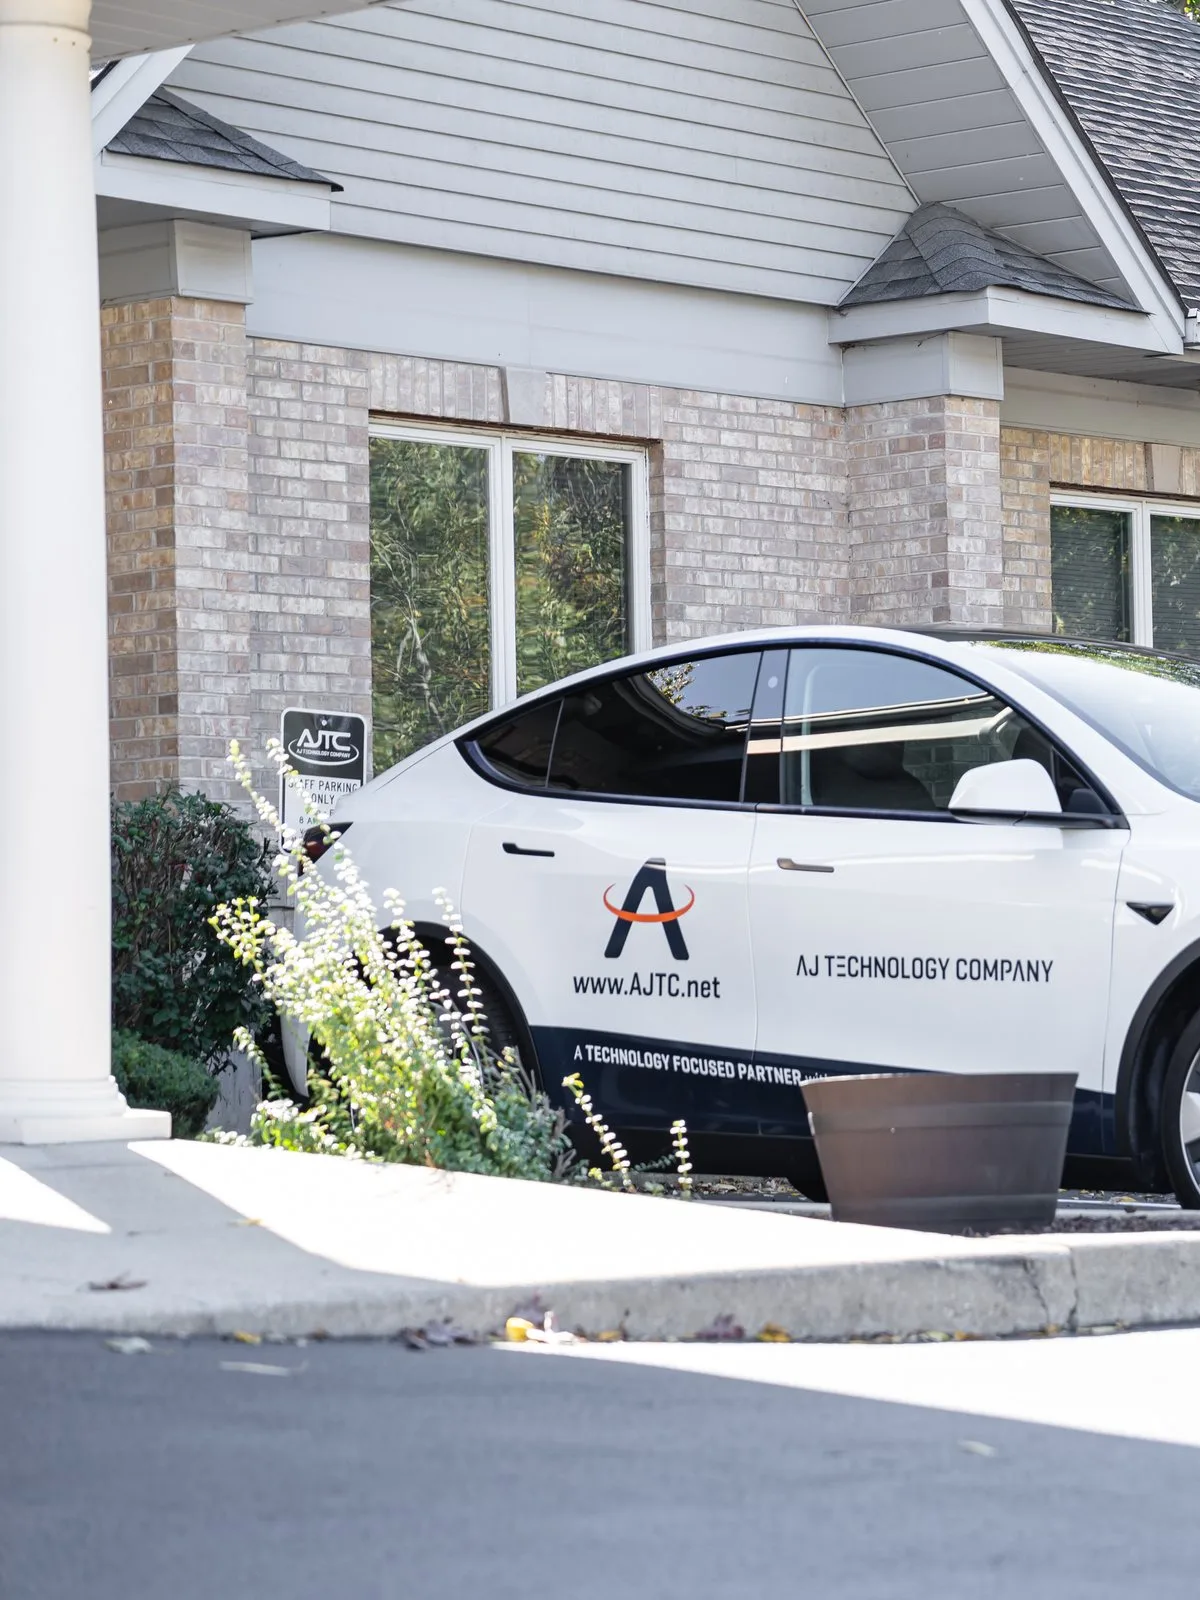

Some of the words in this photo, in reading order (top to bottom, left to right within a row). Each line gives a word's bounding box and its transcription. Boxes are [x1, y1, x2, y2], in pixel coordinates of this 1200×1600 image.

[296, 728, 351, 751] AJTC
[311, 793, 335, 805] ONLY
[796, 955, 819, 977] AJ
[824, 955, 950, 980] TECHNOLOGY
[956, 958, 1054, 983] COMPANY
[573, 971, 721, 998] www.AJTC.net
[574, 1044, 583, 1061] A
[585, 1044, 671, 1071] TECHNOLOGY
[672, 1055, 736, 1079] FOCUSED
[737, 1061, 802, 1086] PARTNER
